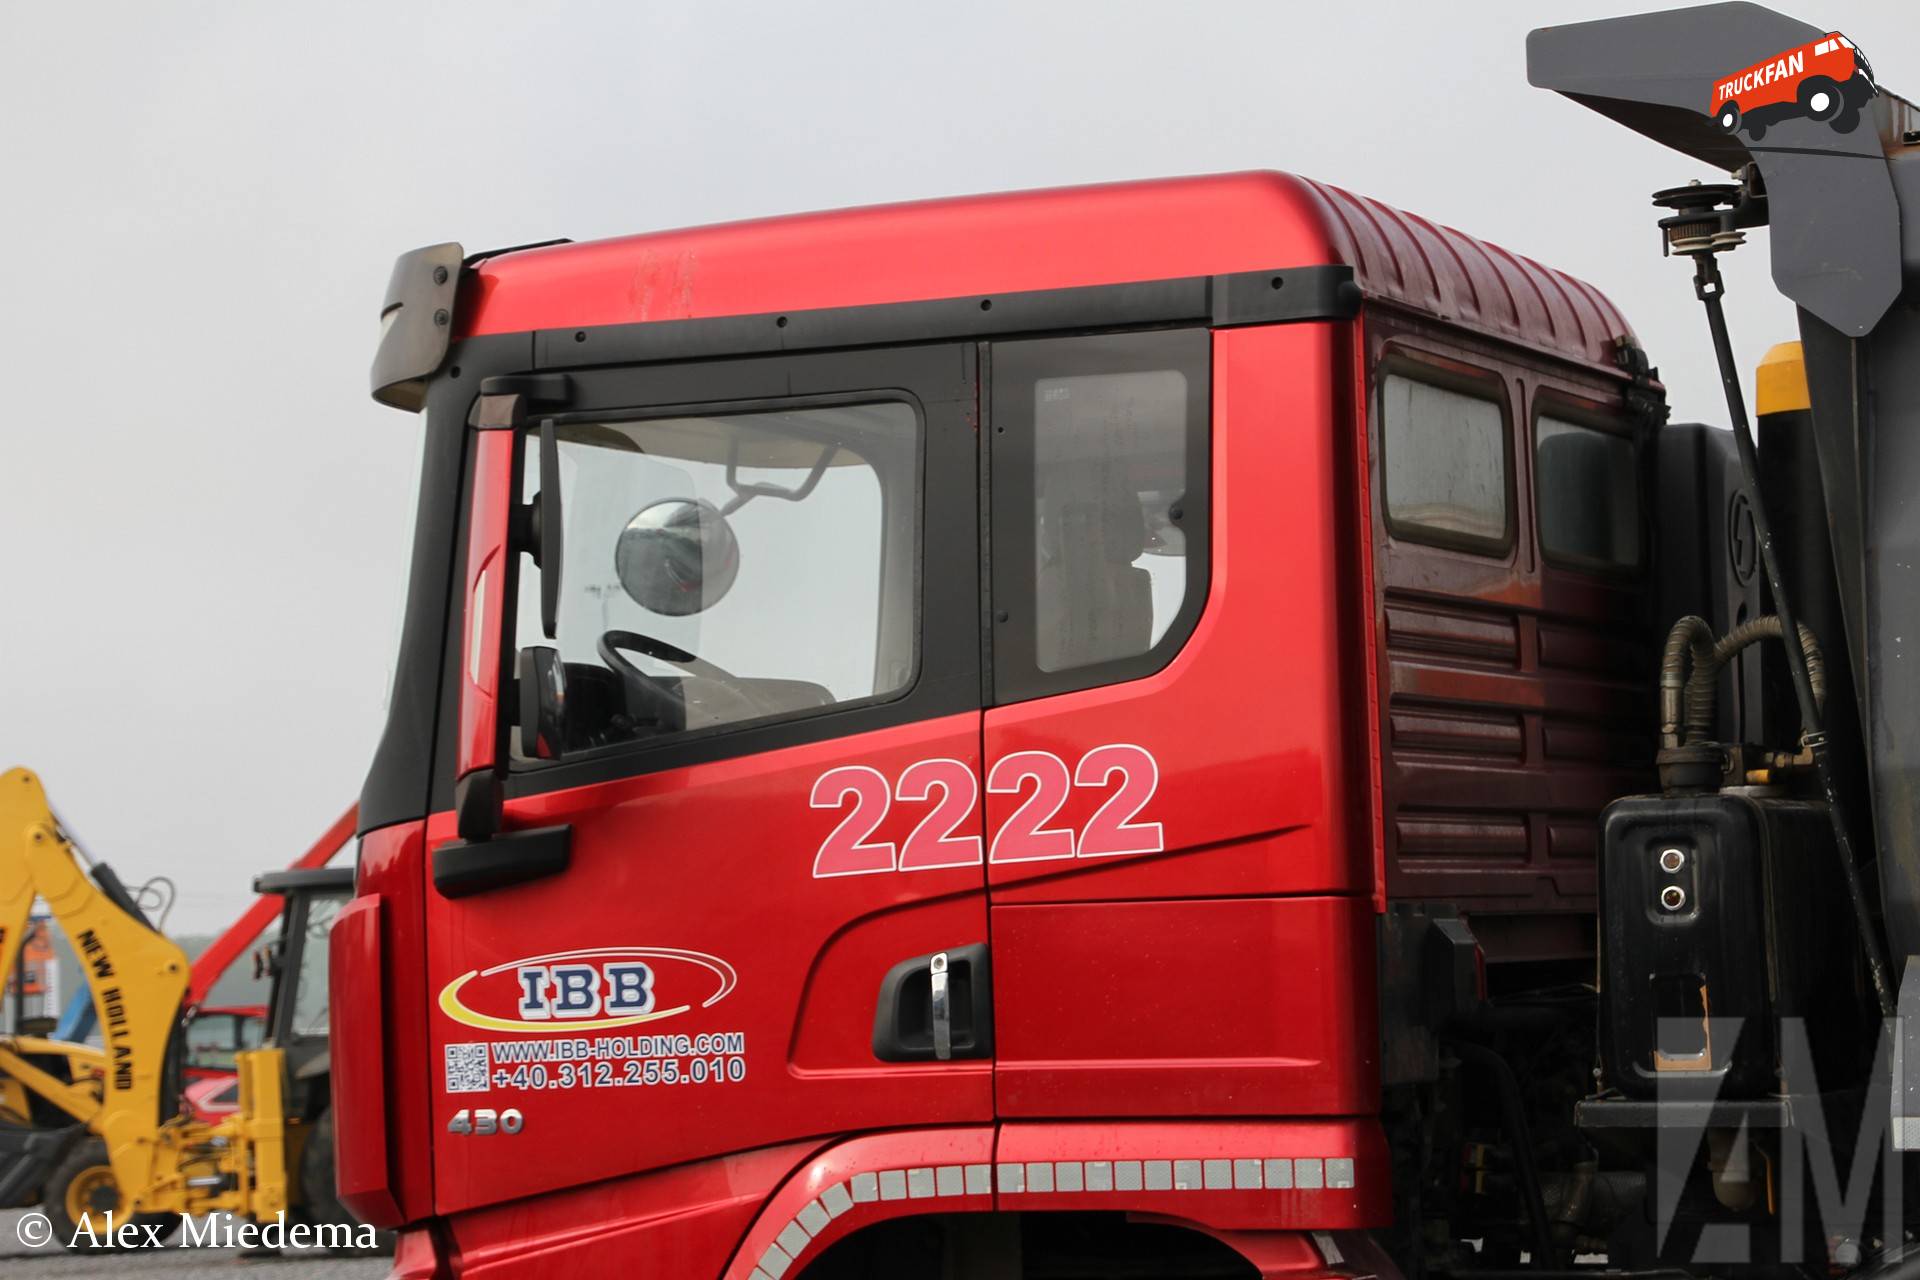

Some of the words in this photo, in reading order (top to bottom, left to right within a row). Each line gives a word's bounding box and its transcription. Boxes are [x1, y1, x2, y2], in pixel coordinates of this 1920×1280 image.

[810, 743, 1164, 879] 2222
[78, 929, 116, 978] NEW
[101, 987, 134, 1091] HOLLAND
[518, 961, 655, 1020] IBB
[490, 1032, 745, 1064] WWW.IBB-HOLDING.COM
[492, 1056, 746, 1090] +40.312.255.010
[447, 1107, 524, 1136] 430
